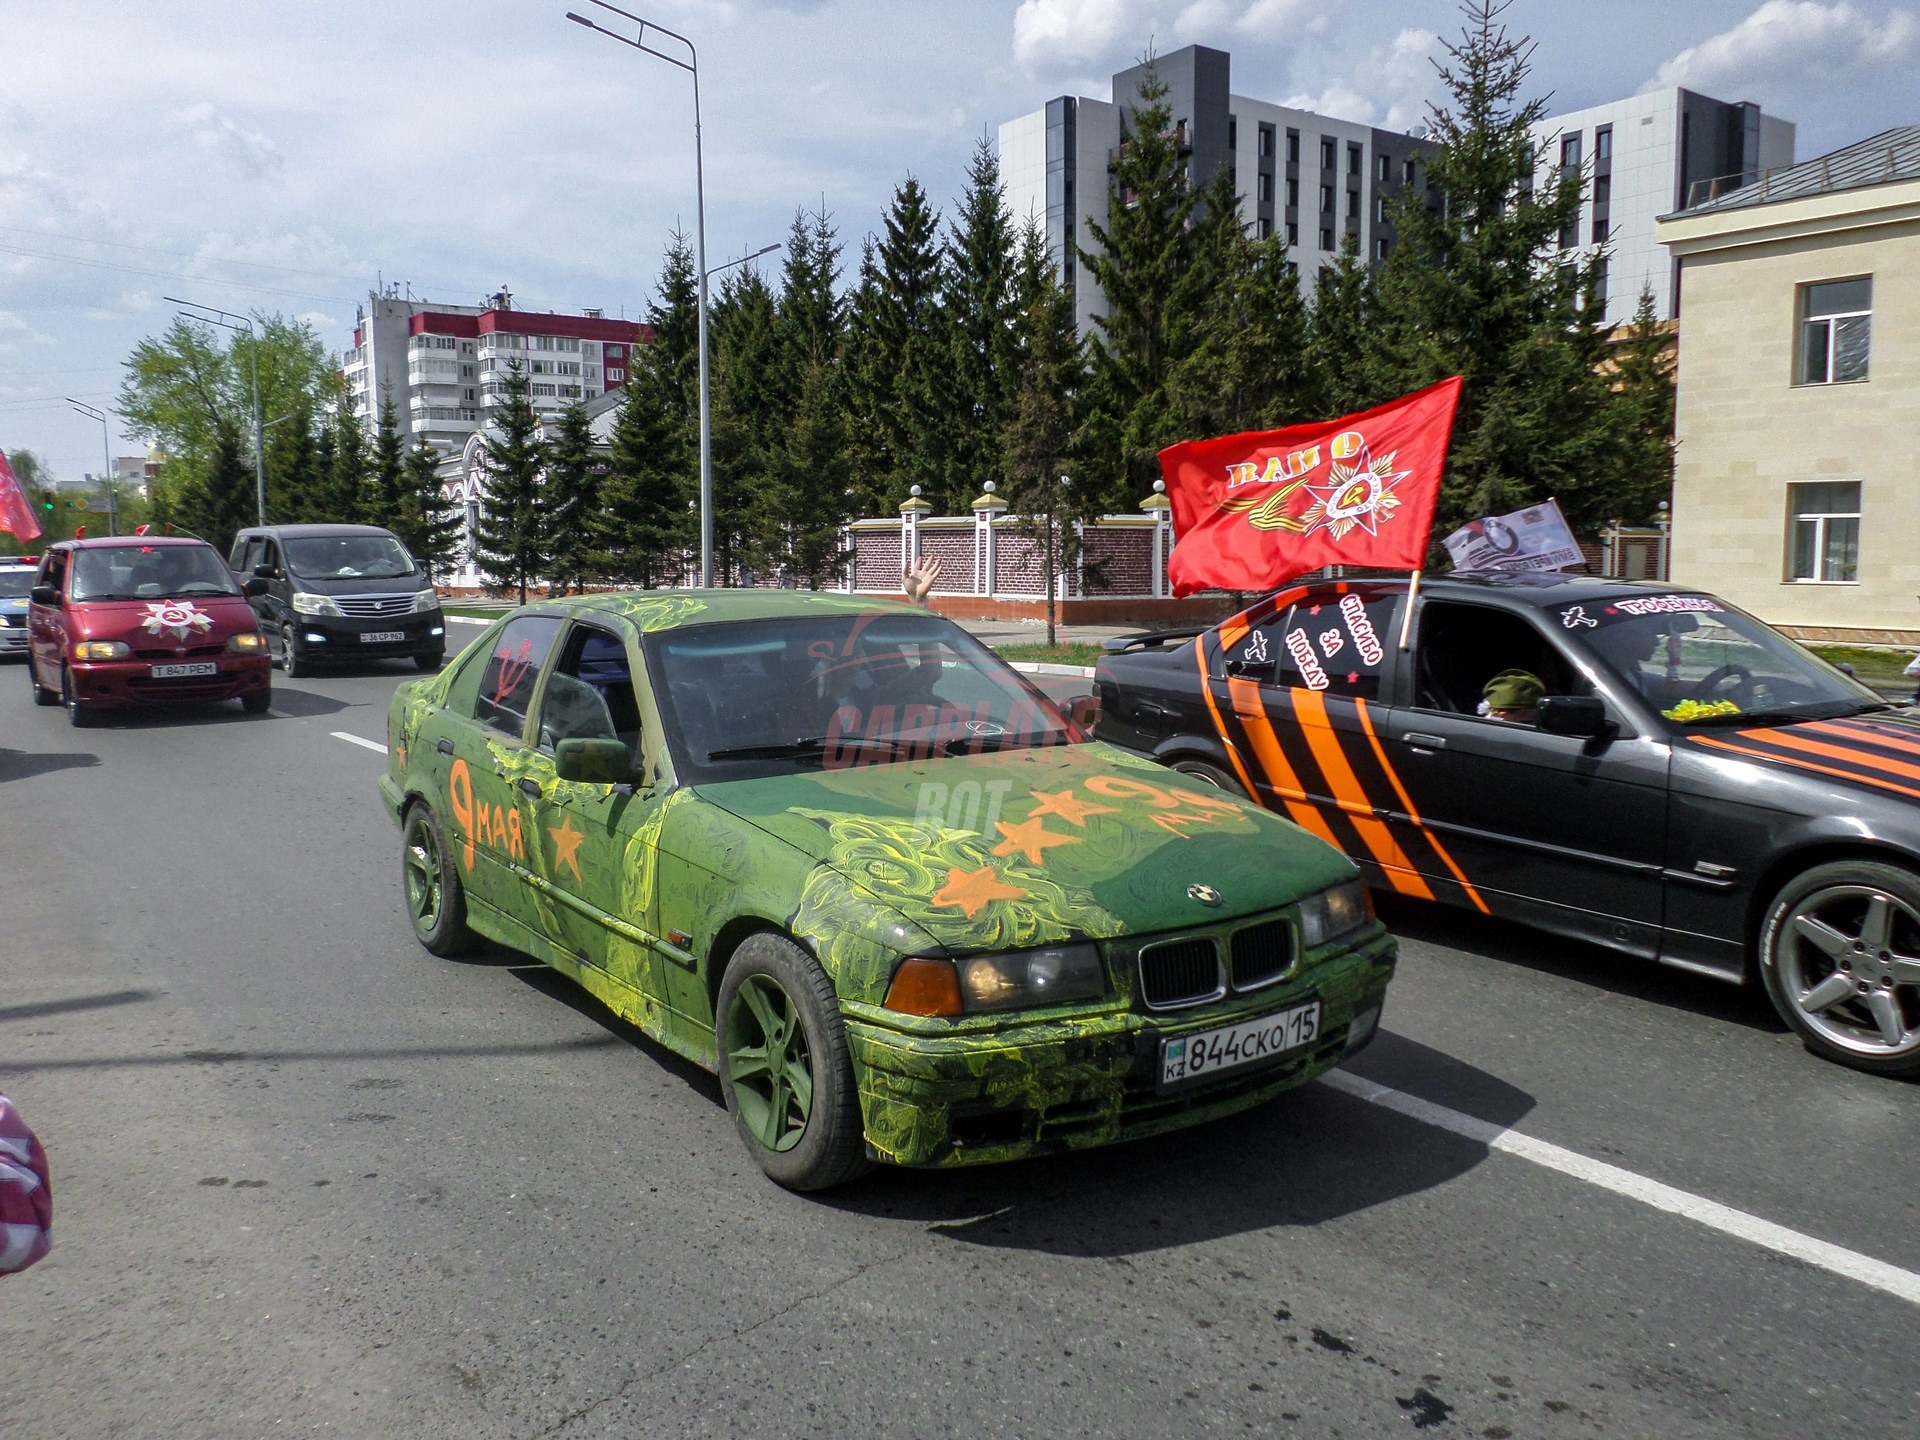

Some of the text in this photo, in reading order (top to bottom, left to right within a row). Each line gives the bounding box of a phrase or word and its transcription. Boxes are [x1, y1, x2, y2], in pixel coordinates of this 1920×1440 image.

[1286, 627, 1330, 690] ПОБЕДУ
[1320, 628, 1344, 658] ЗА
[1339, 593, 1383, 666] СПАСИБО
[166, 665, 187, 676] 847
[190, 664, 213, 675] PEM
[450, 759, 525, 873] 9 МАЯ
[1165, 1061, 1186, 1080] KZ
[1290, 1007, 1316, 1044] 15
